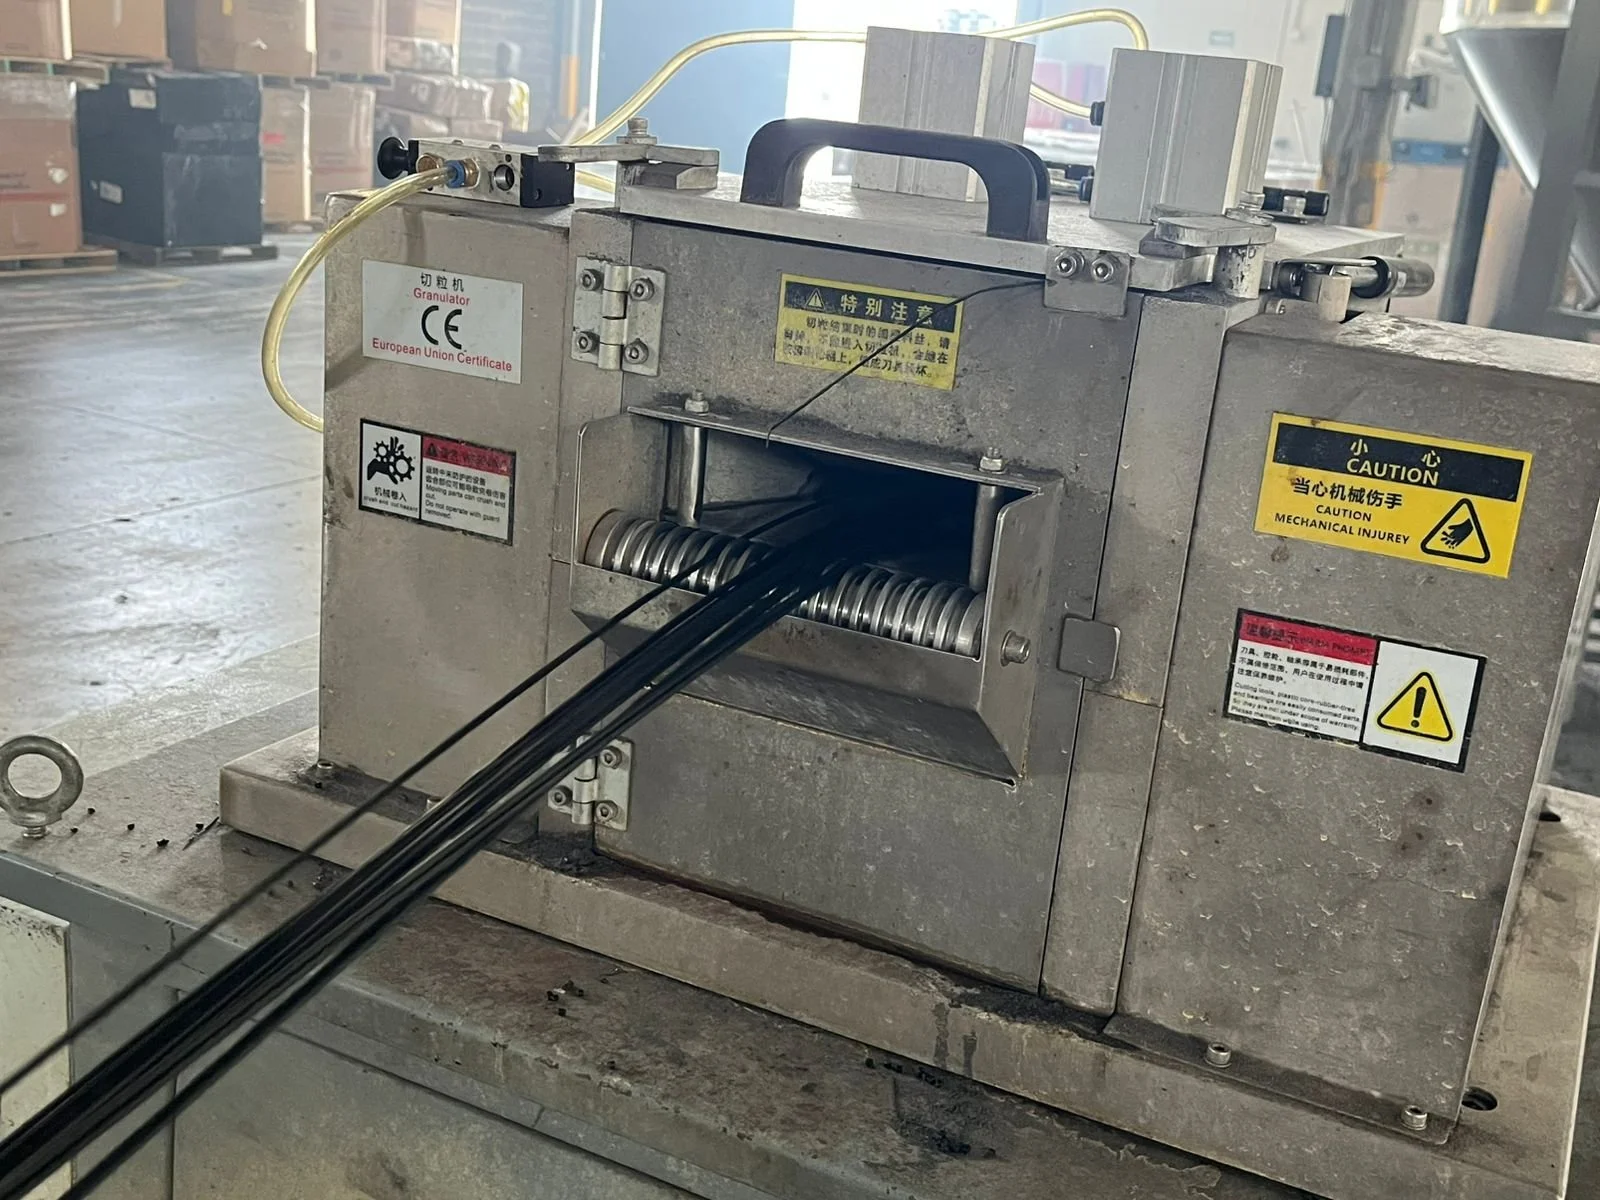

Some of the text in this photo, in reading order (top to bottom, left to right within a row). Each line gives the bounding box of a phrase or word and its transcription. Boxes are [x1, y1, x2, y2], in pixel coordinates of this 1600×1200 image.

[413, 287, 470, 306] Granulator
[420, 272, 464, 292] 切粒机
[841, 294, 933, 325] 特别注意
[421, 305, 463, 350] CE
[372, 337, 512, 372] European Union Certificate
[1346, 458, 1439, 486] CAUTION
[1293, 477, 1403, 510] 当心机械伤手
[1275, 512, 1410, 545] MECHANICAL INJUREY
[1316, 504, 1372, 522] CAUTION
